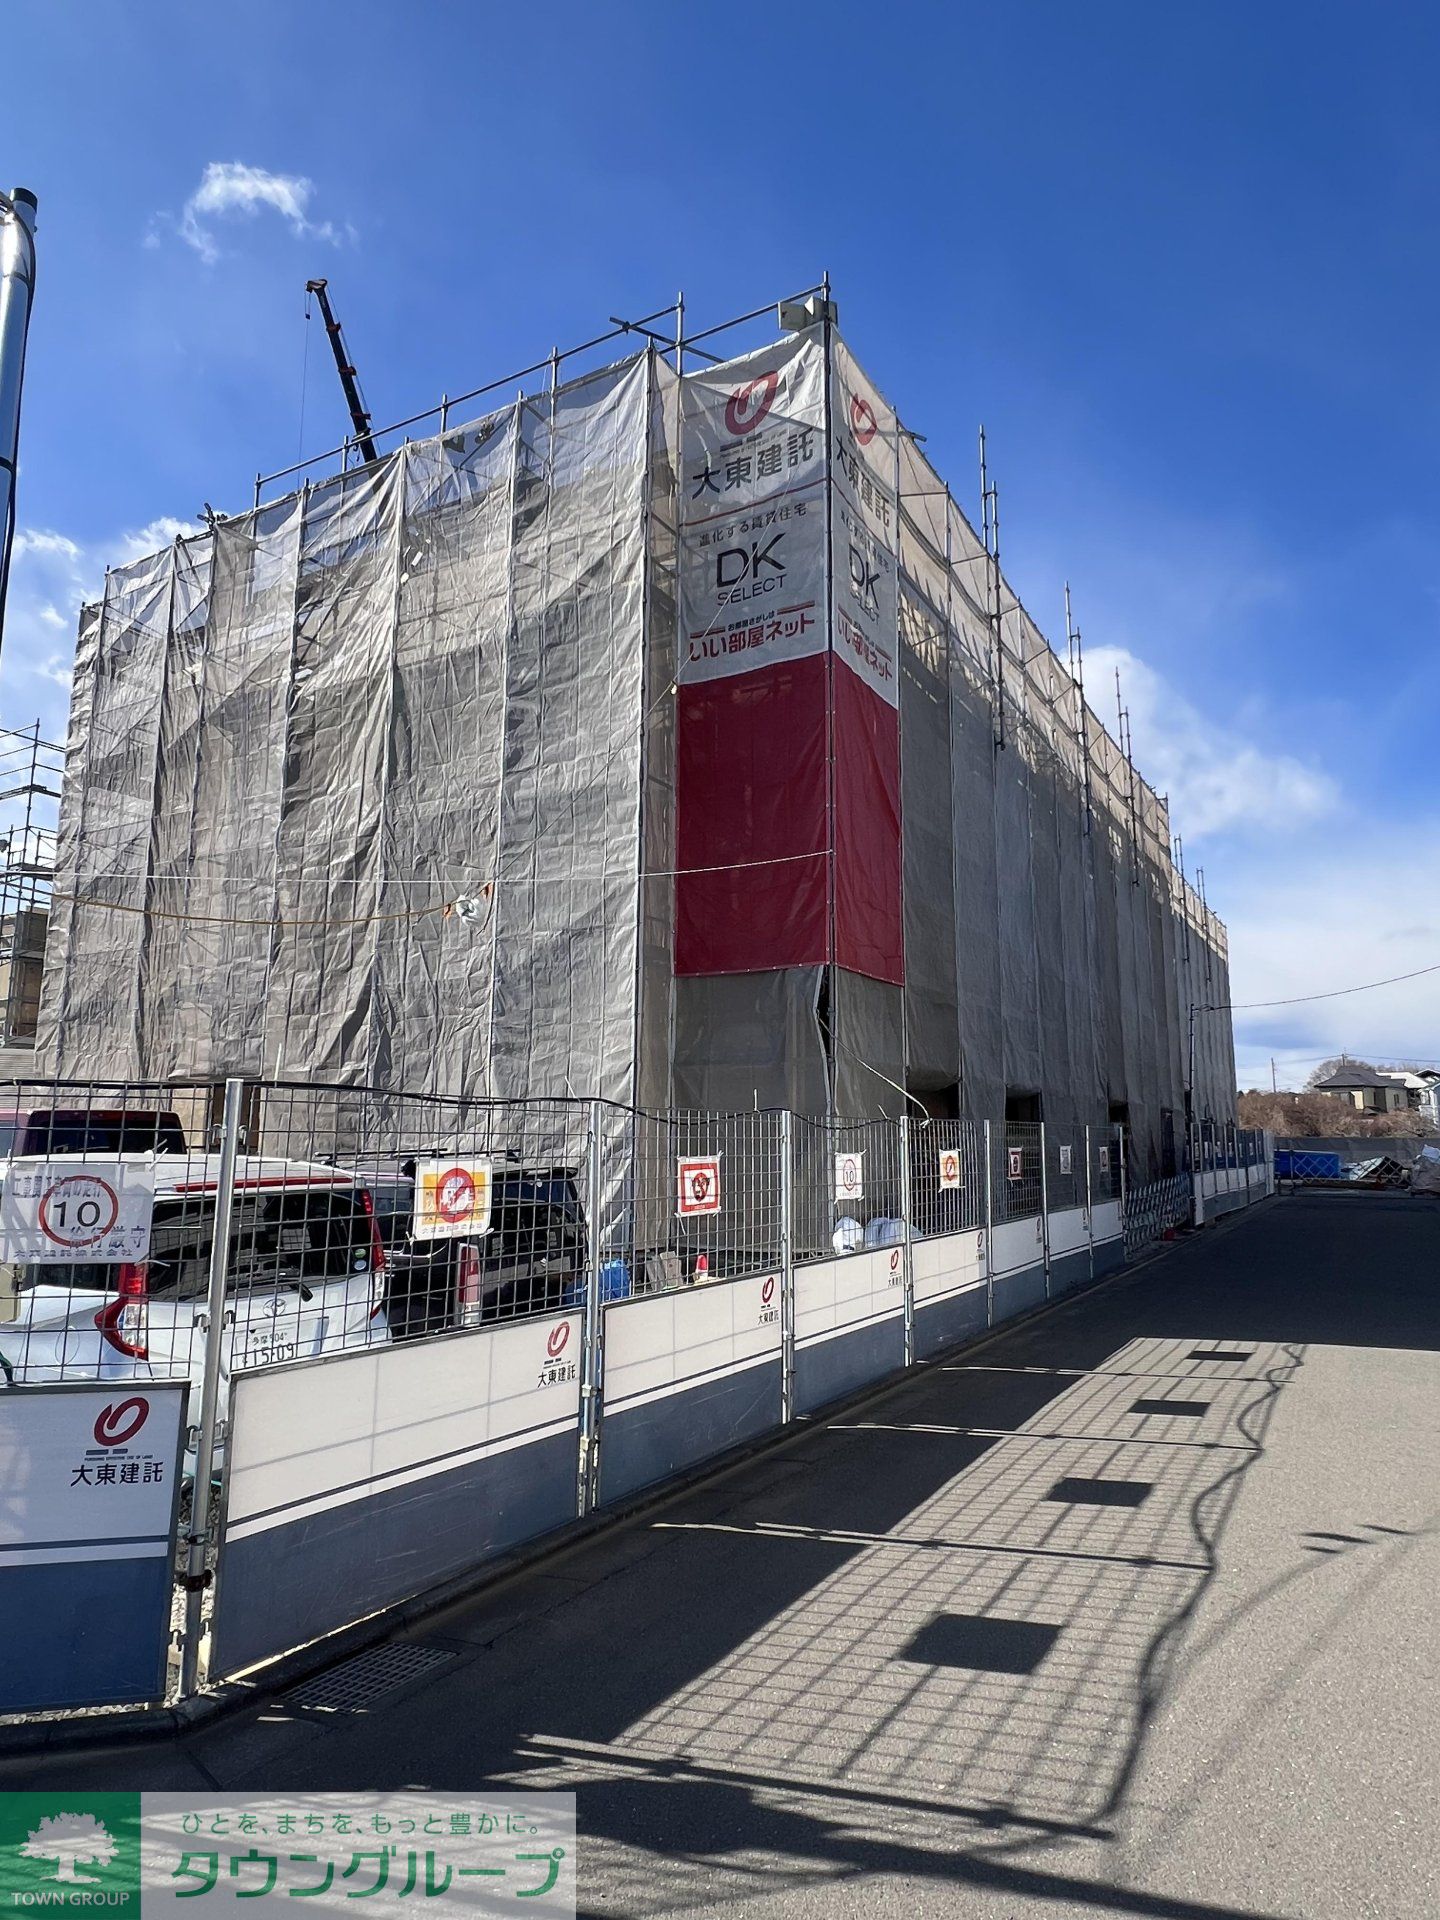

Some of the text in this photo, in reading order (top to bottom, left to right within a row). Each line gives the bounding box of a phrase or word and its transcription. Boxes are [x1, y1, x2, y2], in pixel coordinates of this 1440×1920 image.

[692, 428, 814, 500] 大東建託
[836, 436, 890, 527] 大東建託
[699, 503, 807, 546] 進化する賃貸住宅
[716, 532, 786, 589] DK
[848, 543, 881, 610] DK
[717, 574, 787, 607] SELECT
[689, 612, 815, 662] いい部屋ネット
[845, 1171, 854, 1182] 10
[53, 1201, 101, 1227] 10
[70, 1226, 146, 1249] 徐行厳守
[537, 1364, 576, 1388] 大東建託
[70, 1461, 164, 1487] 大東建託
